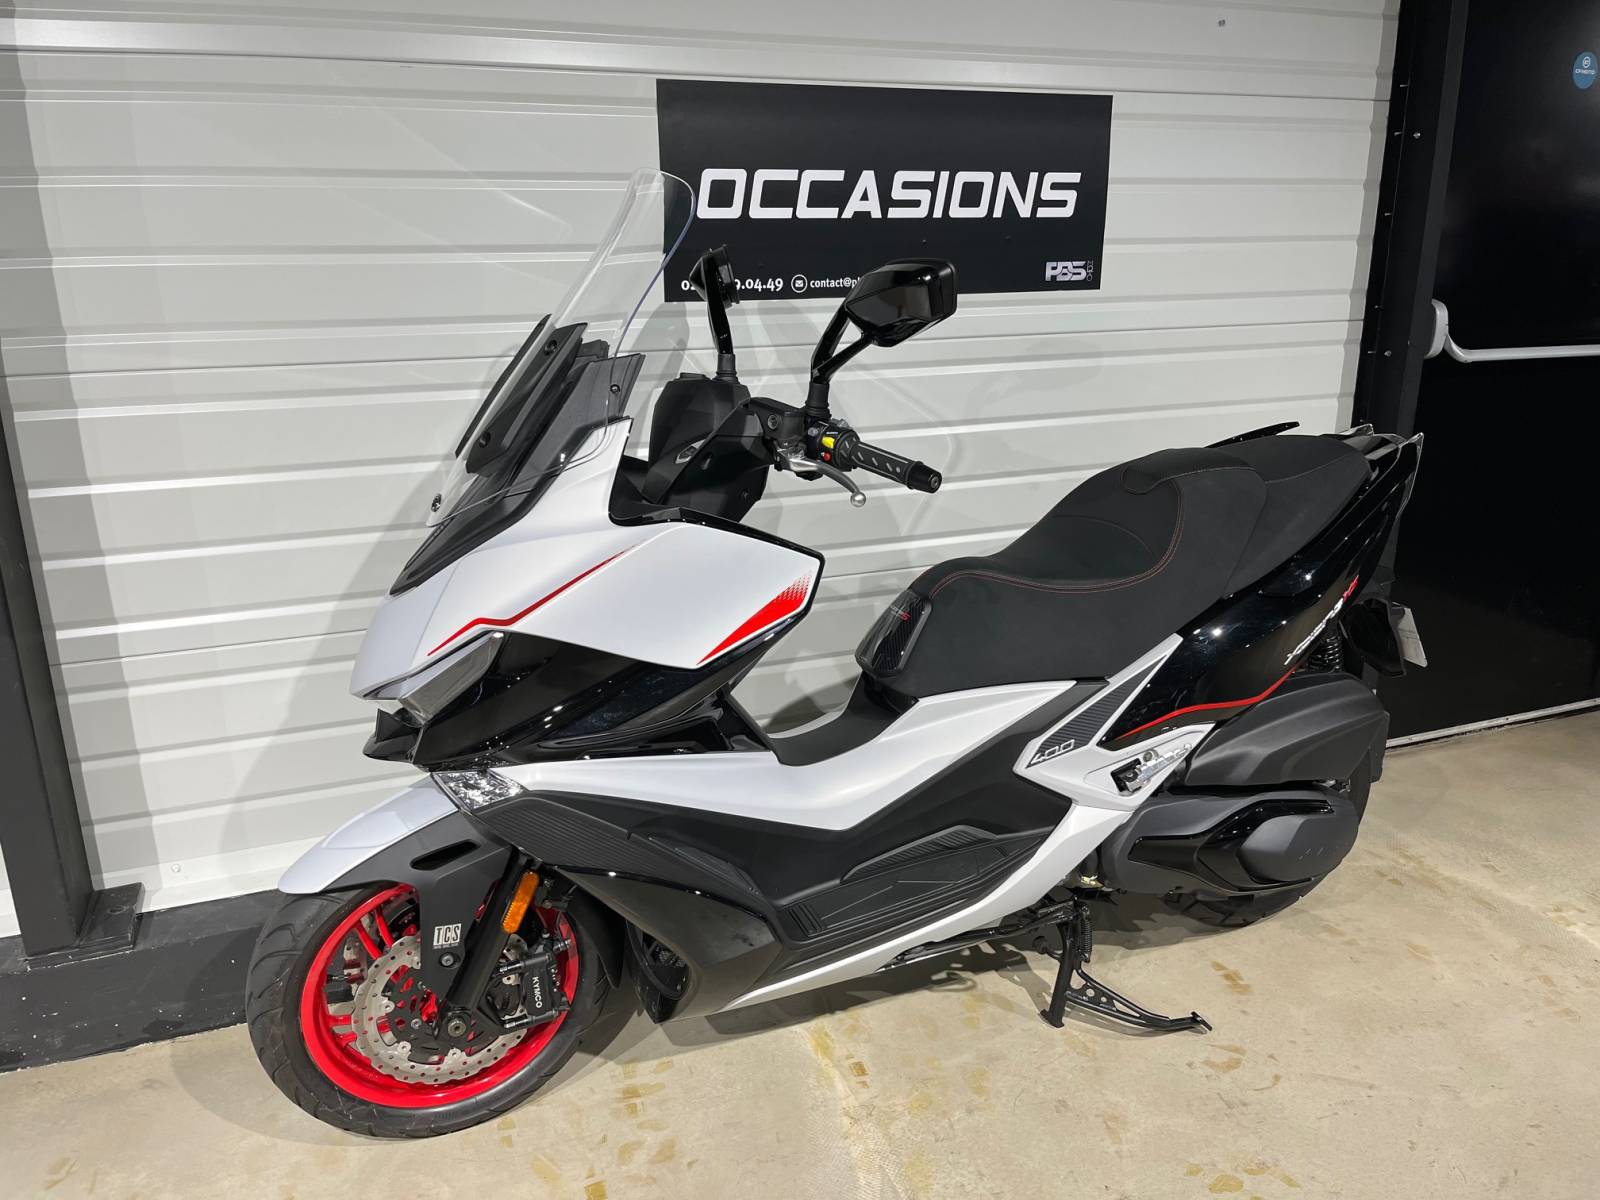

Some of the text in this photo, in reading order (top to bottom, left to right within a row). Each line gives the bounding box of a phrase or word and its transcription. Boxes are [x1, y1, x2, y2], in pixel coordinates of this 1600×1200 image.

[697, 168, 1082, 219] OCCASIONS
[809, 276, 860, 289] contact@p
[1030, 739, 1075, 764] 400
[434, 924, 461, 946] TCS
[532, 976, 543, 1009] KYMCO
